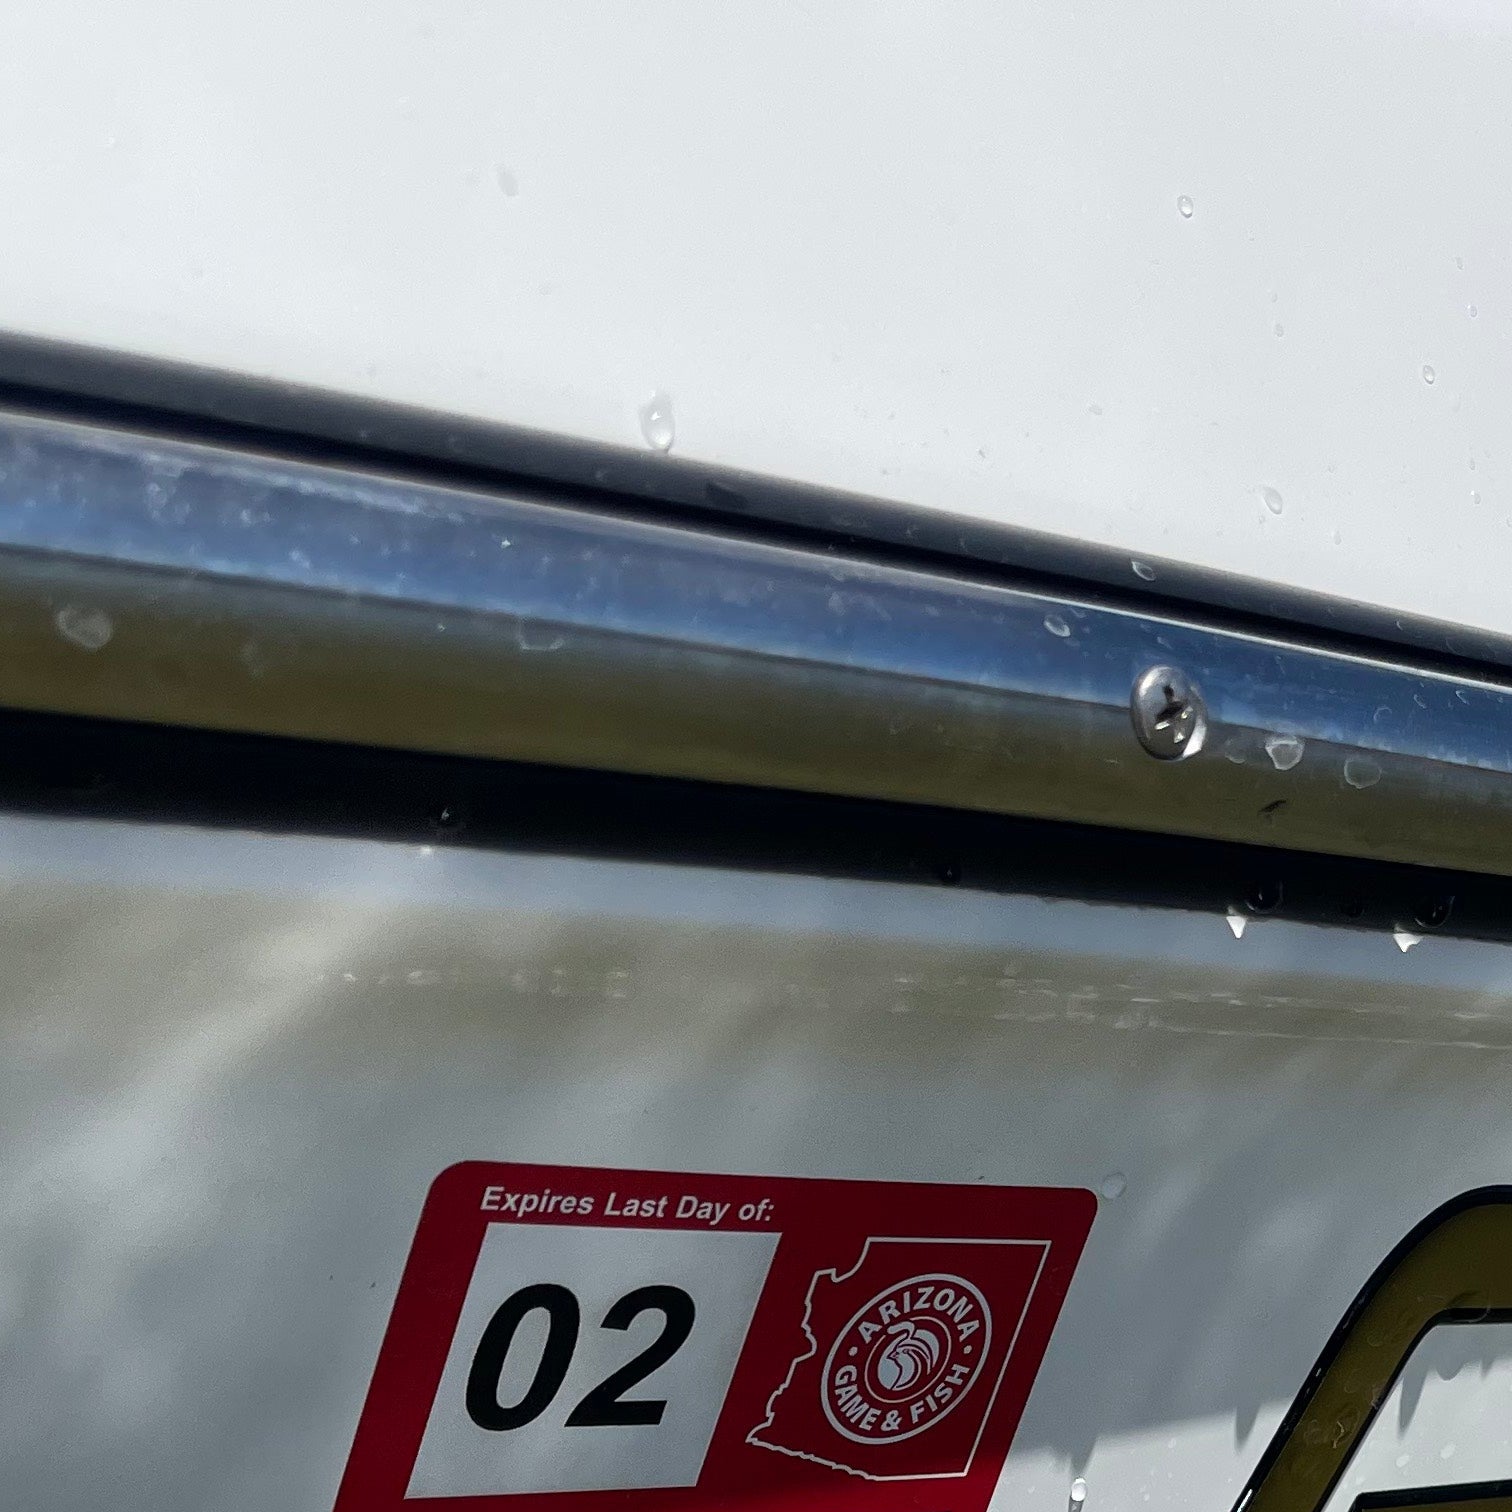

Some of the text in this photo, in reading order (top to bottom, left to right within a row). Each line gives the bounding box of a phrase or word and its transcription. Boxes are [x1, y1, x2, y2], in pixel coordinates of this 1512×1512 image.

[480, 1186, 774, 1225] Expires Last Day of:
[858, 1286, 980, 1344] ARIZONA
[464, 1283, 696, 1431] 02
[835, 1364, 970, 1432] GAME & FISH
